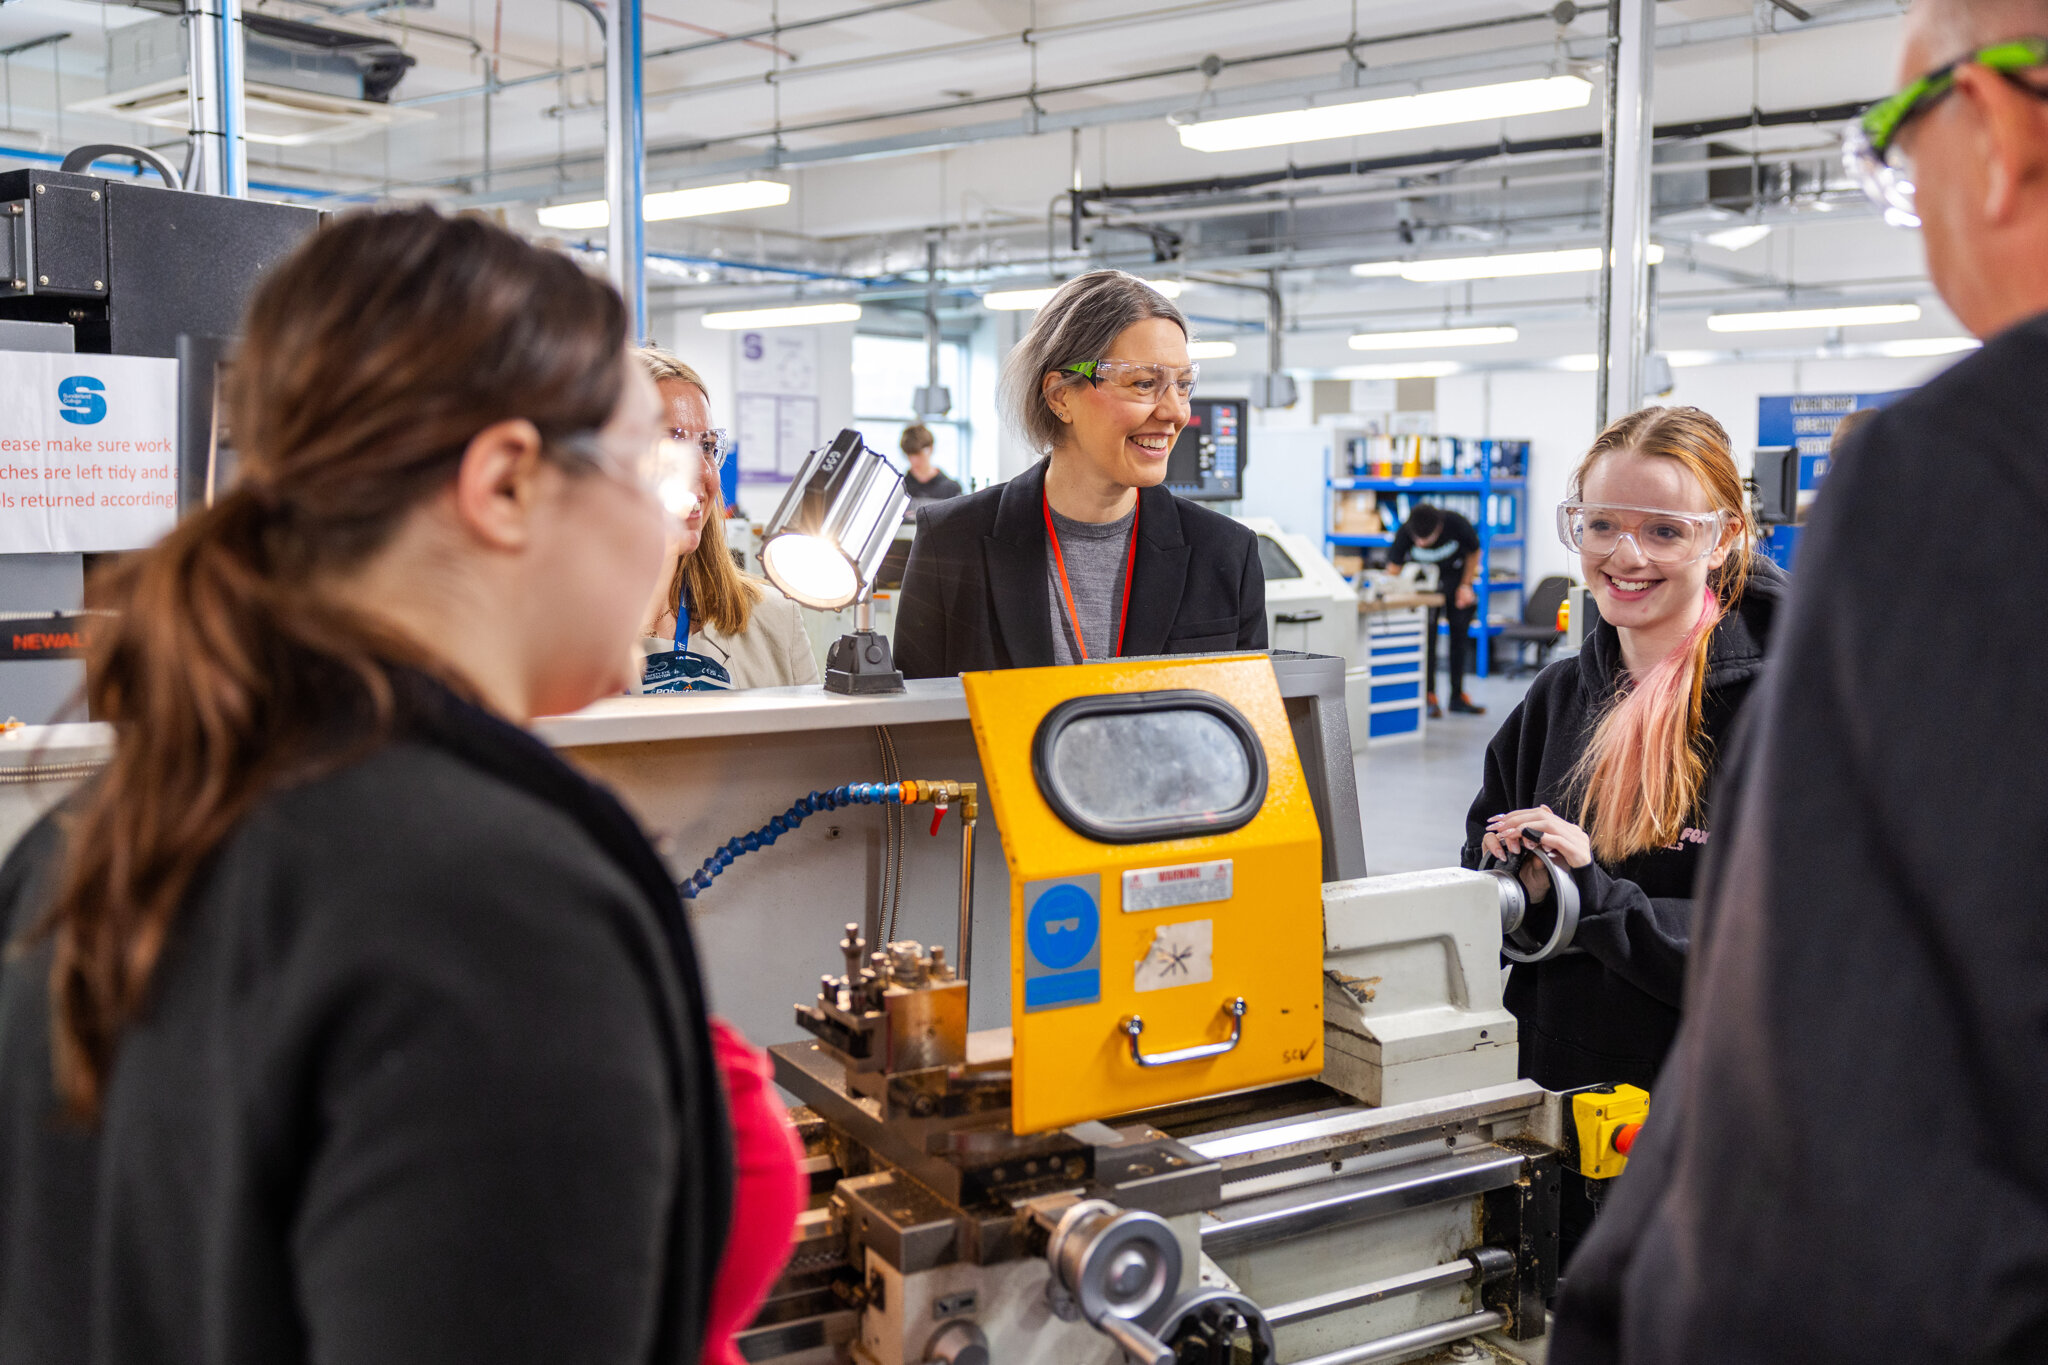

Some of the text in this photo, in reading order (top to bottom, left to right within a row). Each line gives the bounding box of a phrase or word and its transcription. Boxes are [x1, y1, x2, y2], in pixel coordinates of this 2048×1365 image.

[47, 436, 92, 452] make
[97, 440, 130, 452] sure
[135, 438, 172, 452] work
[44, 467, 71, 480] are
[76, 464, 103, 480] left
[108, 465, 137, 482] tidy
[141, 464, 168, 480] and
[0, 492, 15, 508] ls
[21, 491, 95, 508] returned
[1157, 867, 1202, 884] WARNING
